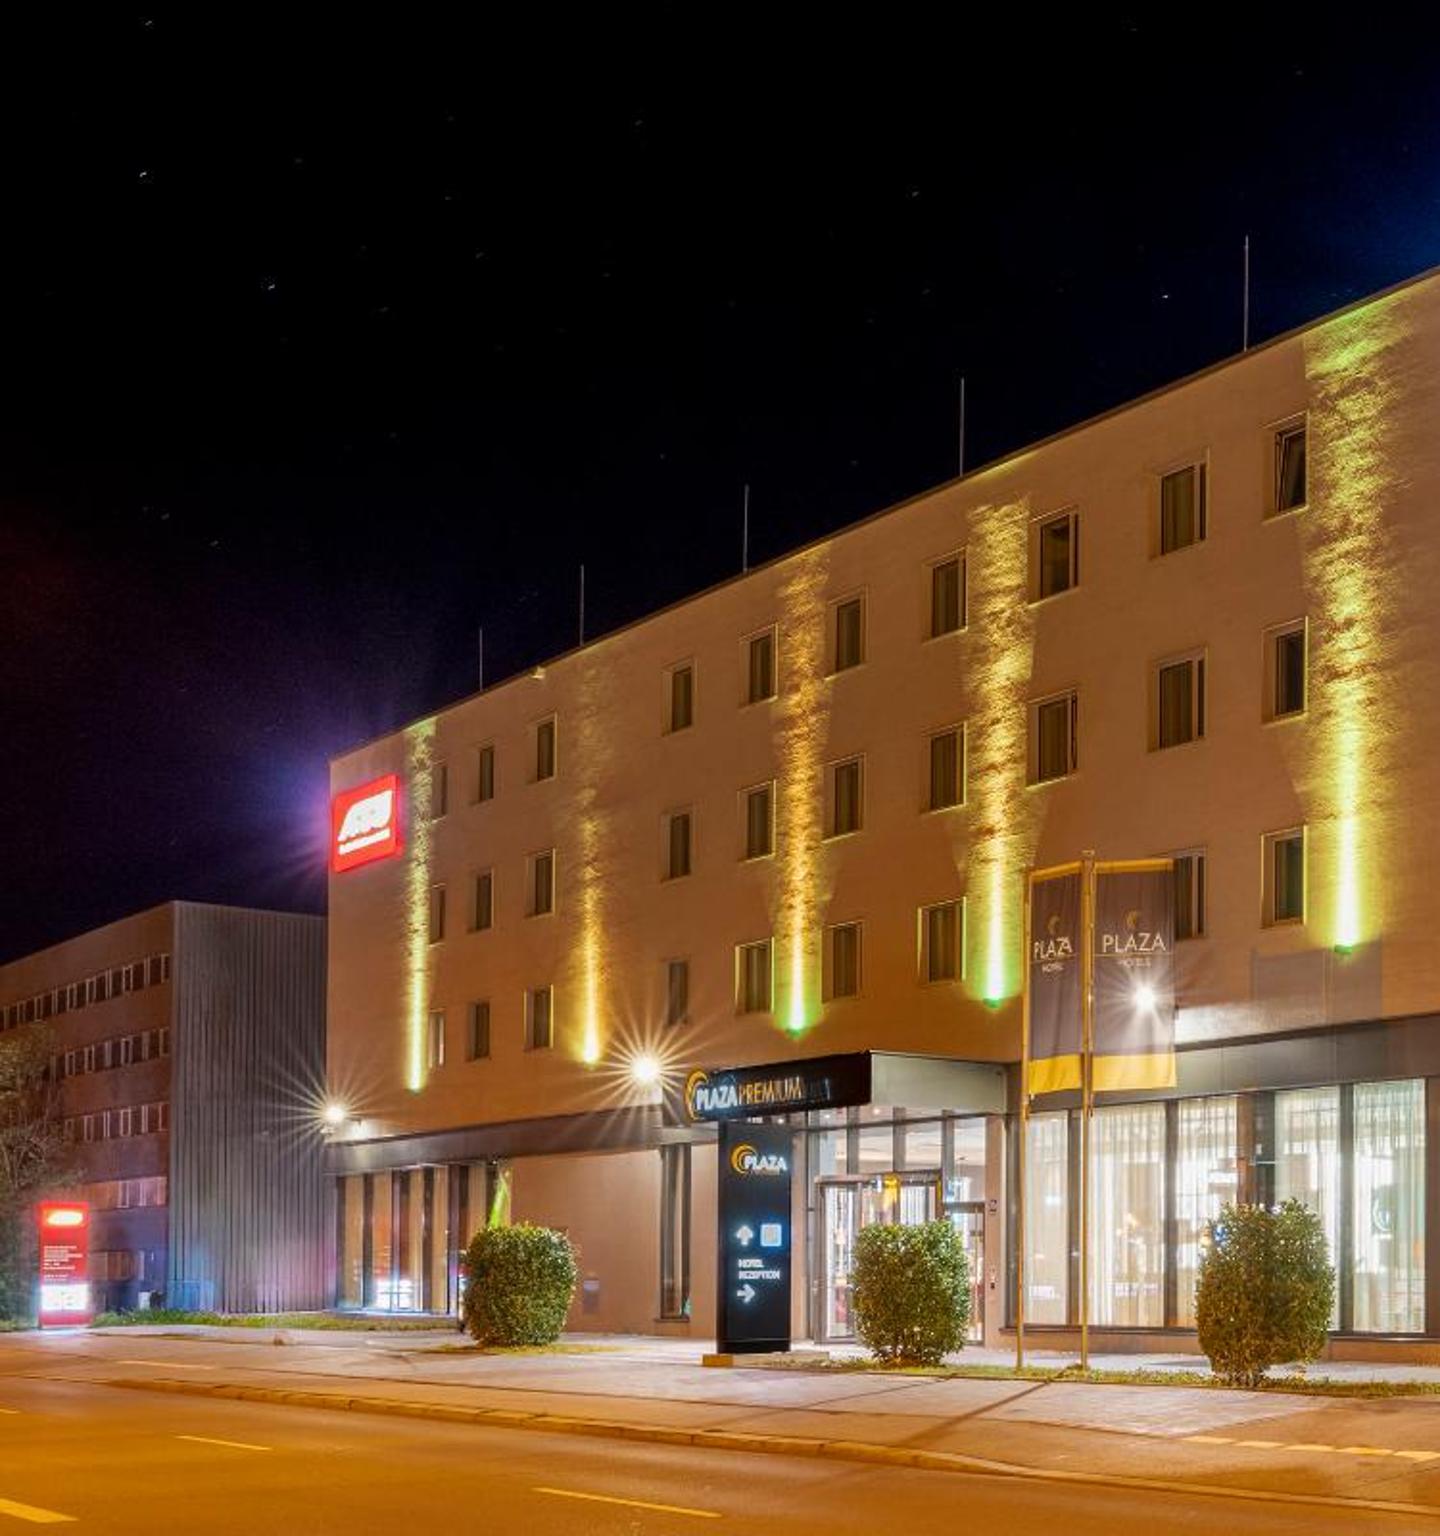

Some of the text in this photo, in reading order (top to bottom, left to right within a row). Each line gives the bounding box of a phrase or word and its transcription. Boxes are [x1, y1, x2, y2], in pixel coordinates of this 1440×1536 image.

[1033, 936, 1073, 961] PLAZA
[1103, 931, 1166, 954] PLAZA
[696, 1084, 739, 1112] PLAZA
[739, 1075, 803, 1106] PREMIUM
[744, 1155, 788, 1172] PLAZA
